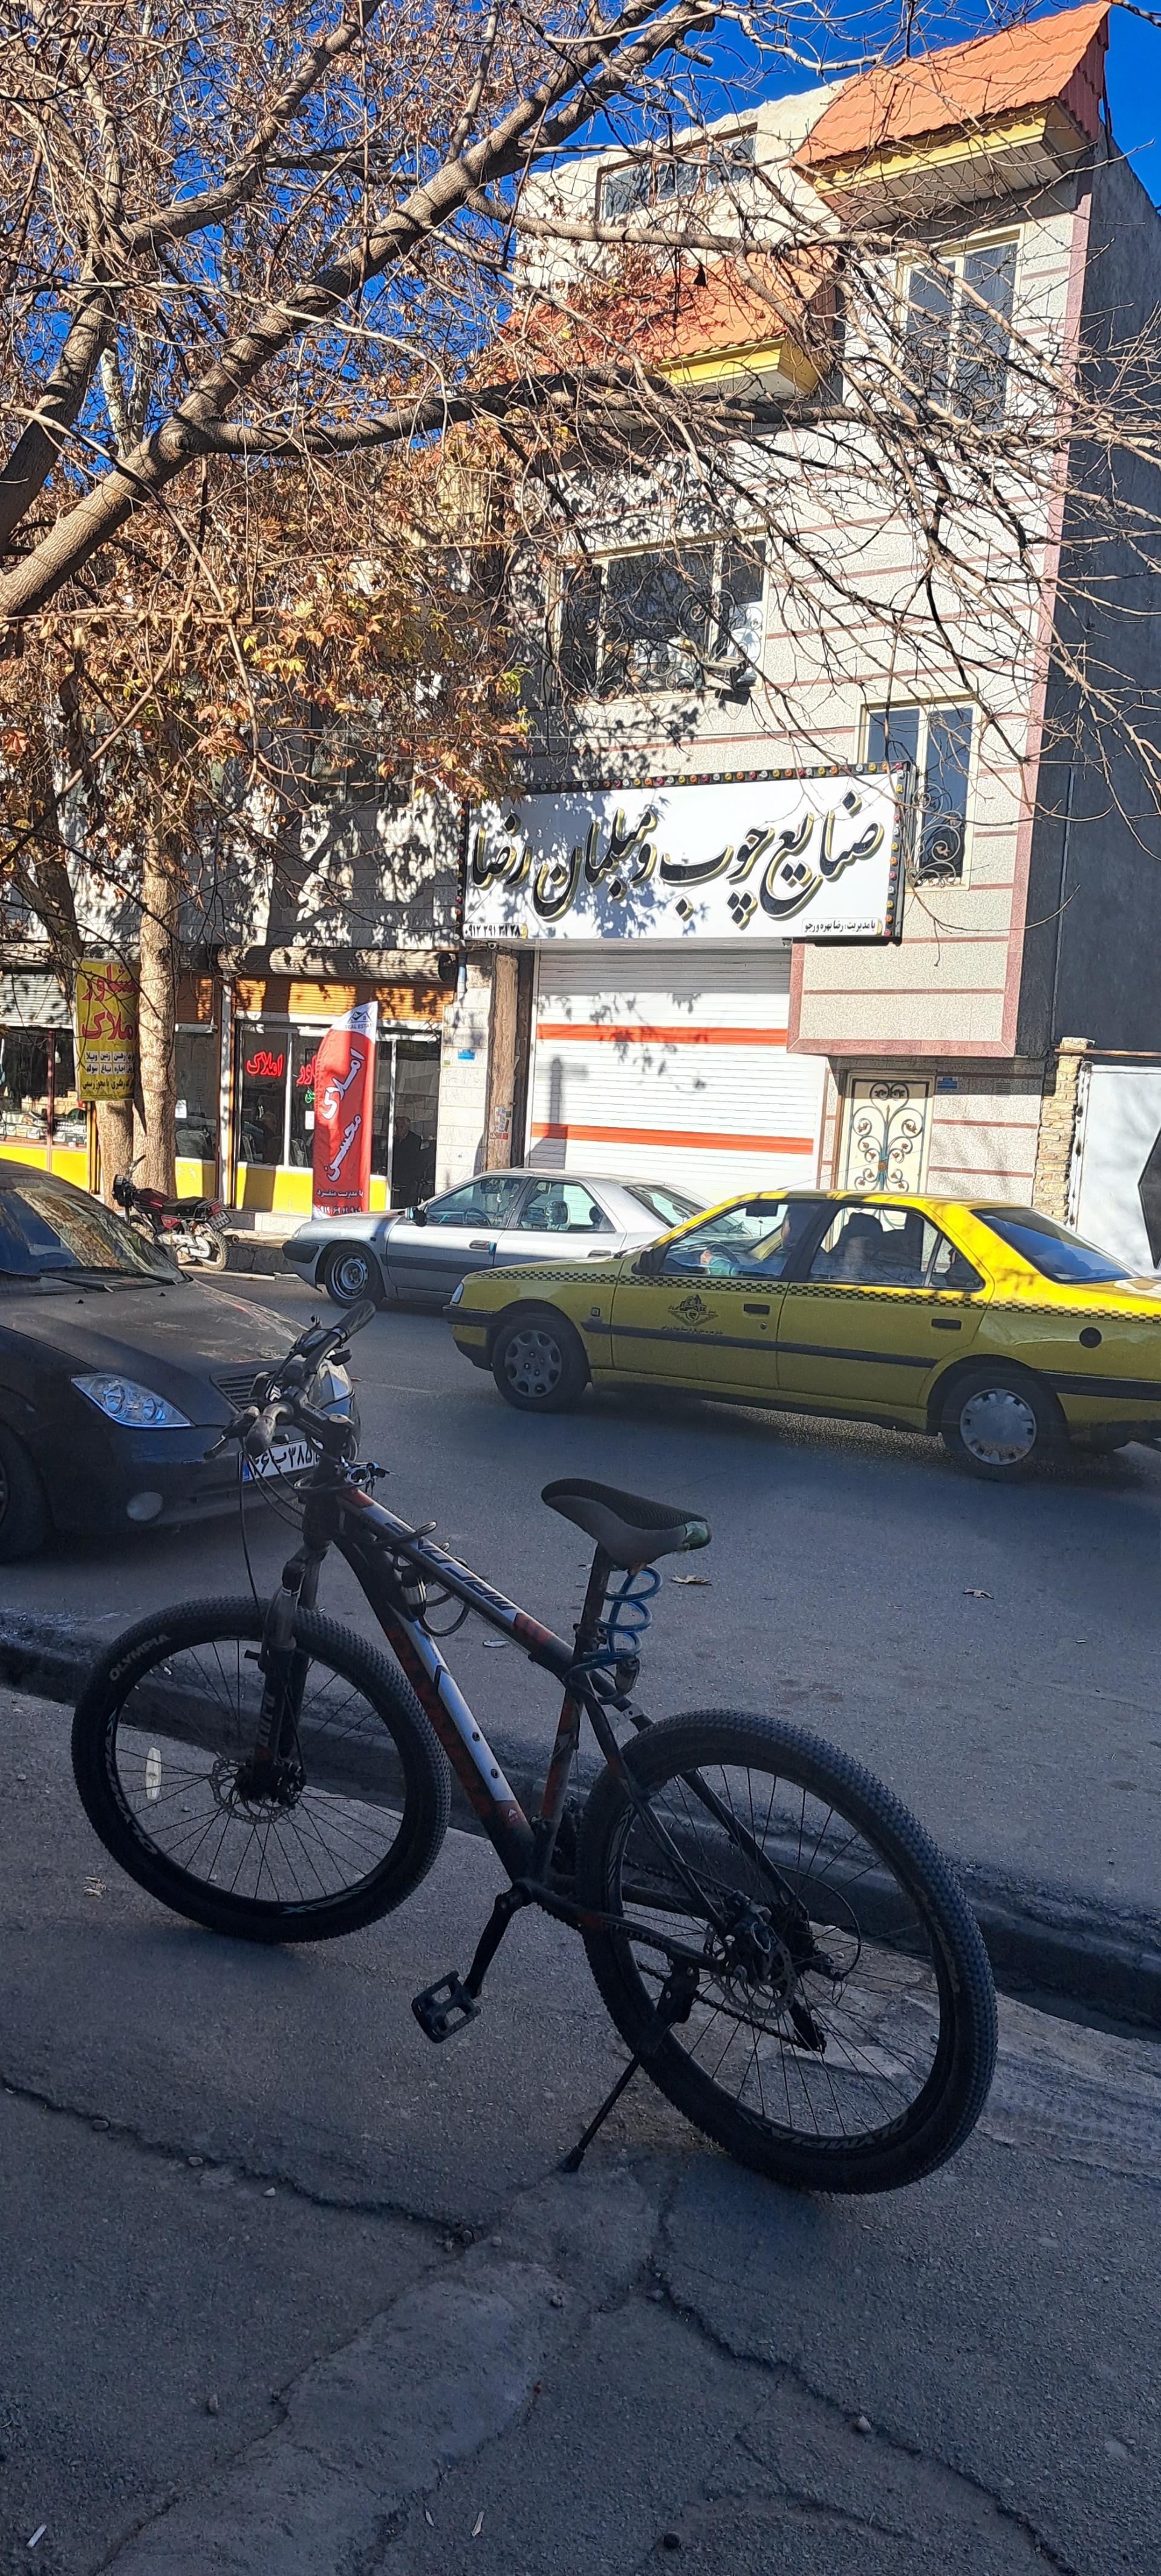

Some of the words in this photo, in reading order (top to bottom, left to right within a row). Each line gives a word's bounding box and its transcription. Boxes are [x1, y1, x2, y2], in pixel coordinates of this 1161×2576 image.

[472, 813, 533, 891] رضا
[532, 808, 657, 923] مبلمان
[628, 842, 657, 888] و
[659, 827, 776, 930] چوب
[759, 789, 885, 922] صنایع
[833, 920, 844, 932] رضا
[871, 920, 876, 931] با
[86, 1052, 97, 1061] ویلا
[246, 1051, 283, 1077] املاک
[320, 1047, 365, 1119] املاک
[324, 1115, 362, 1182] محسن
[109, 1634, 171, 1681] OLYMPIA
